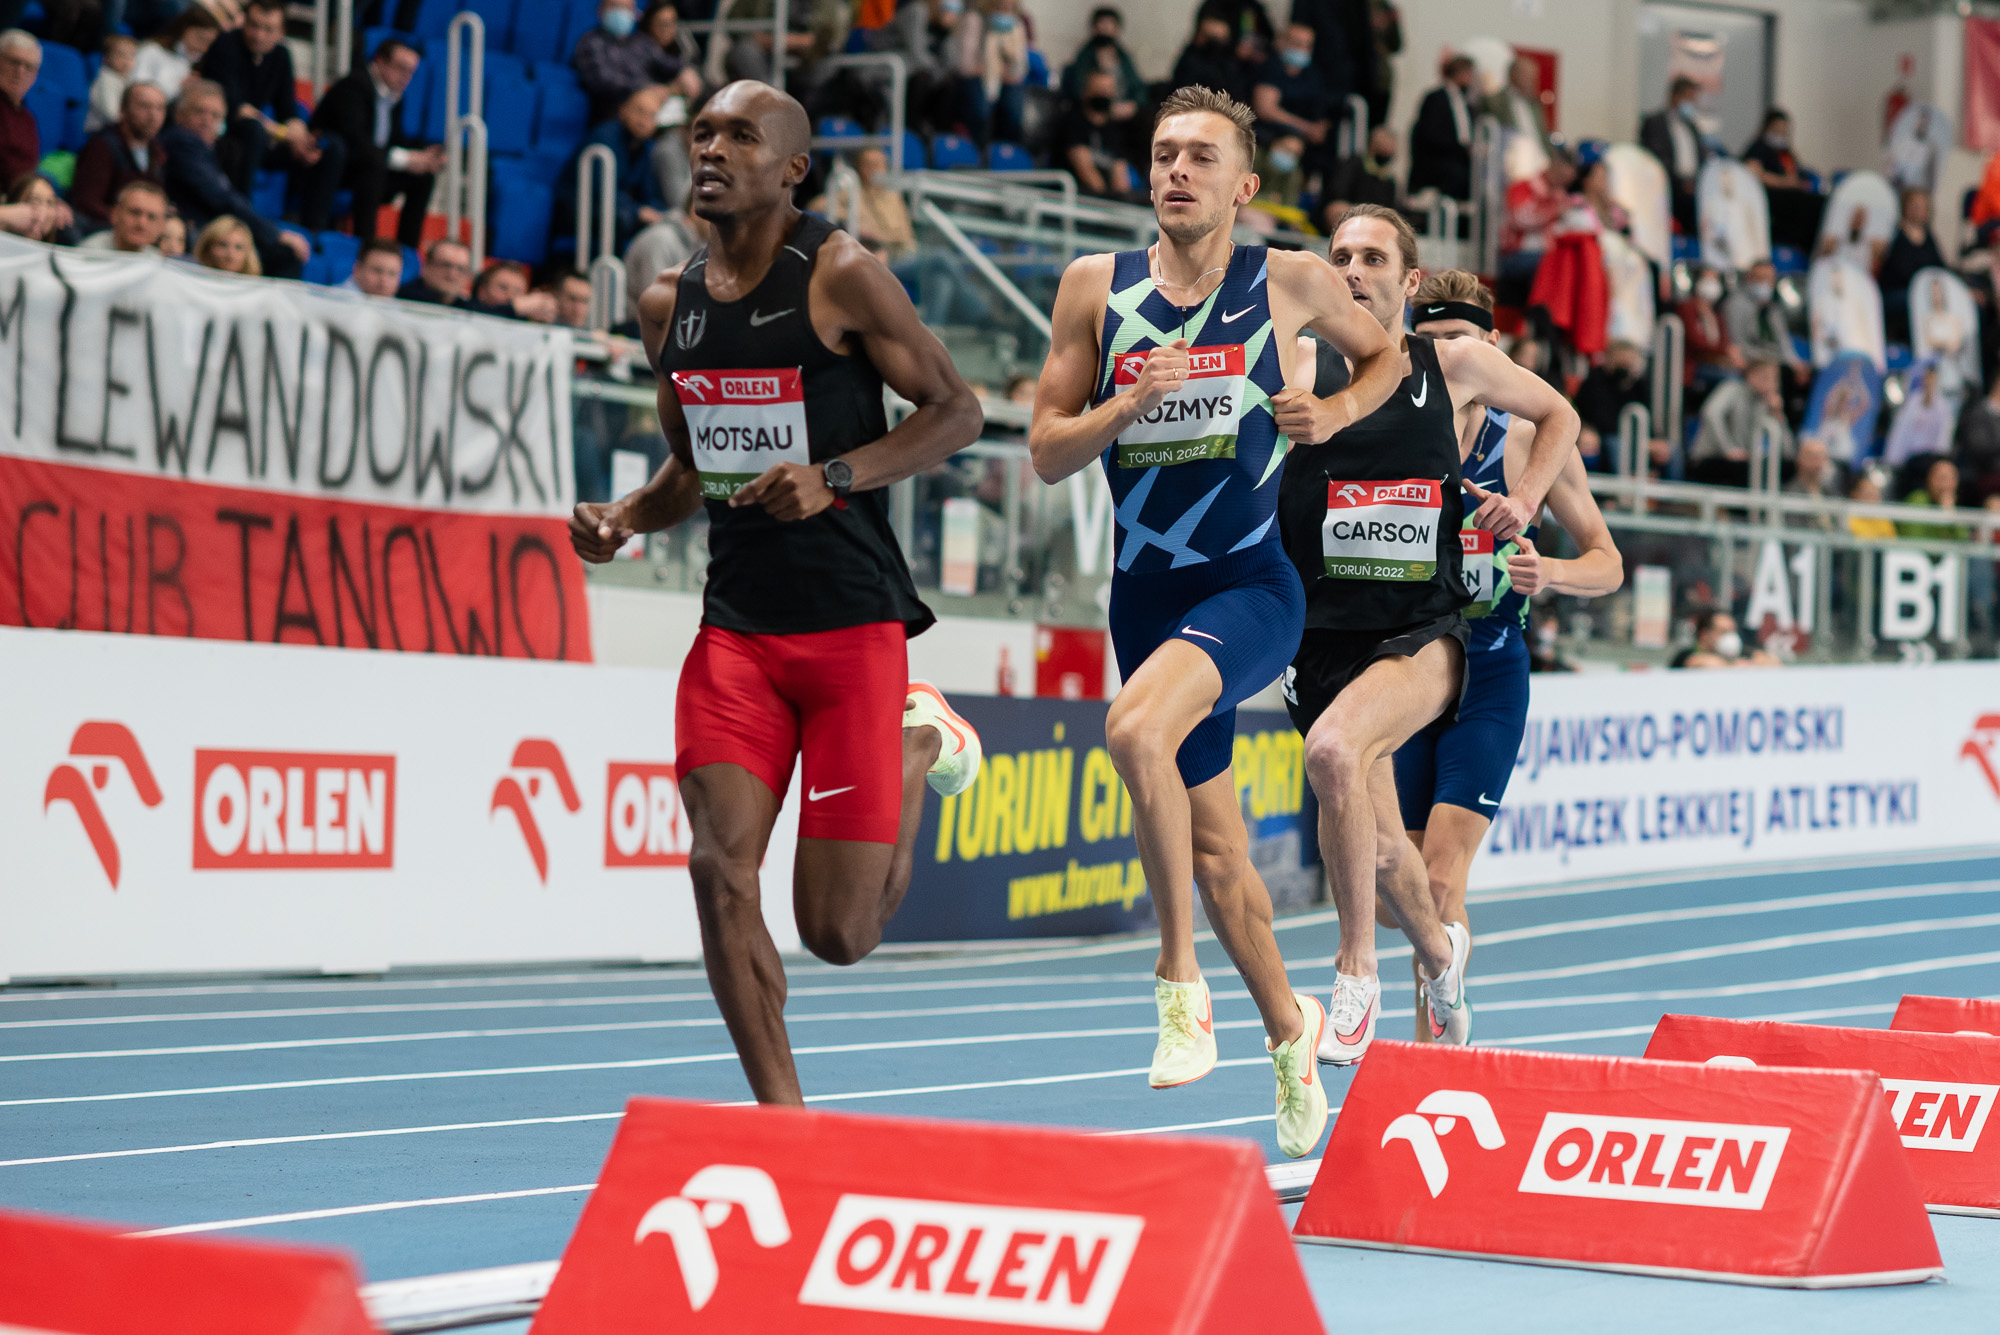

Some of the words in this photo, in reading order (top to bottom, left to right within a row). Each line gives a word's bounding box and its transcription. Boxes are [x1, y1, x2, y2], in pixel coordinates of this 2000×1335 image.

[50, 252, 562, 505] LEWANDOWSKI
[724, 380, 775, 396] ORLEN
[1189, 355, 1222, 371] LEN
[696, 425, 793, 451] MOTSAU
[1132, 395, 1233, 425] OZMYS
[701, 479, 731, 496] ORUŃ
[1127, 447, 1173, 464] TORUŃ
[1176, 444, 1207, 461] 2022
[1376, 486, 1427, 500] ORLEN
[1332, 520, 1430, 544] CARSON
[216, 508, 569, 660] TANOWO
[1331, 562, 1371, 576] TORUŃ
[1374, 566, 1405, 578] 2022
[1745, 538, 1816, 633] A1
[1880, 549, 1958, 643] B1
[1231, 728, 1305, 821] PORT
[1514, 706, 1845, 782] UJAWSKO-POMORSKI
[201, 762, 387, 857] ORLEN
[610, 774, 693, 857] ORL
[1638, 788, 1755, 848] LEKKIEJ
[1765, 780, 1919, 832] ATLETYKI
[1008, 858, 1147, 920] www.torun.p
[1542, 1126, 1768, 1194] ORLEN
[835, 1218, 1111, 1305] ORLEN
